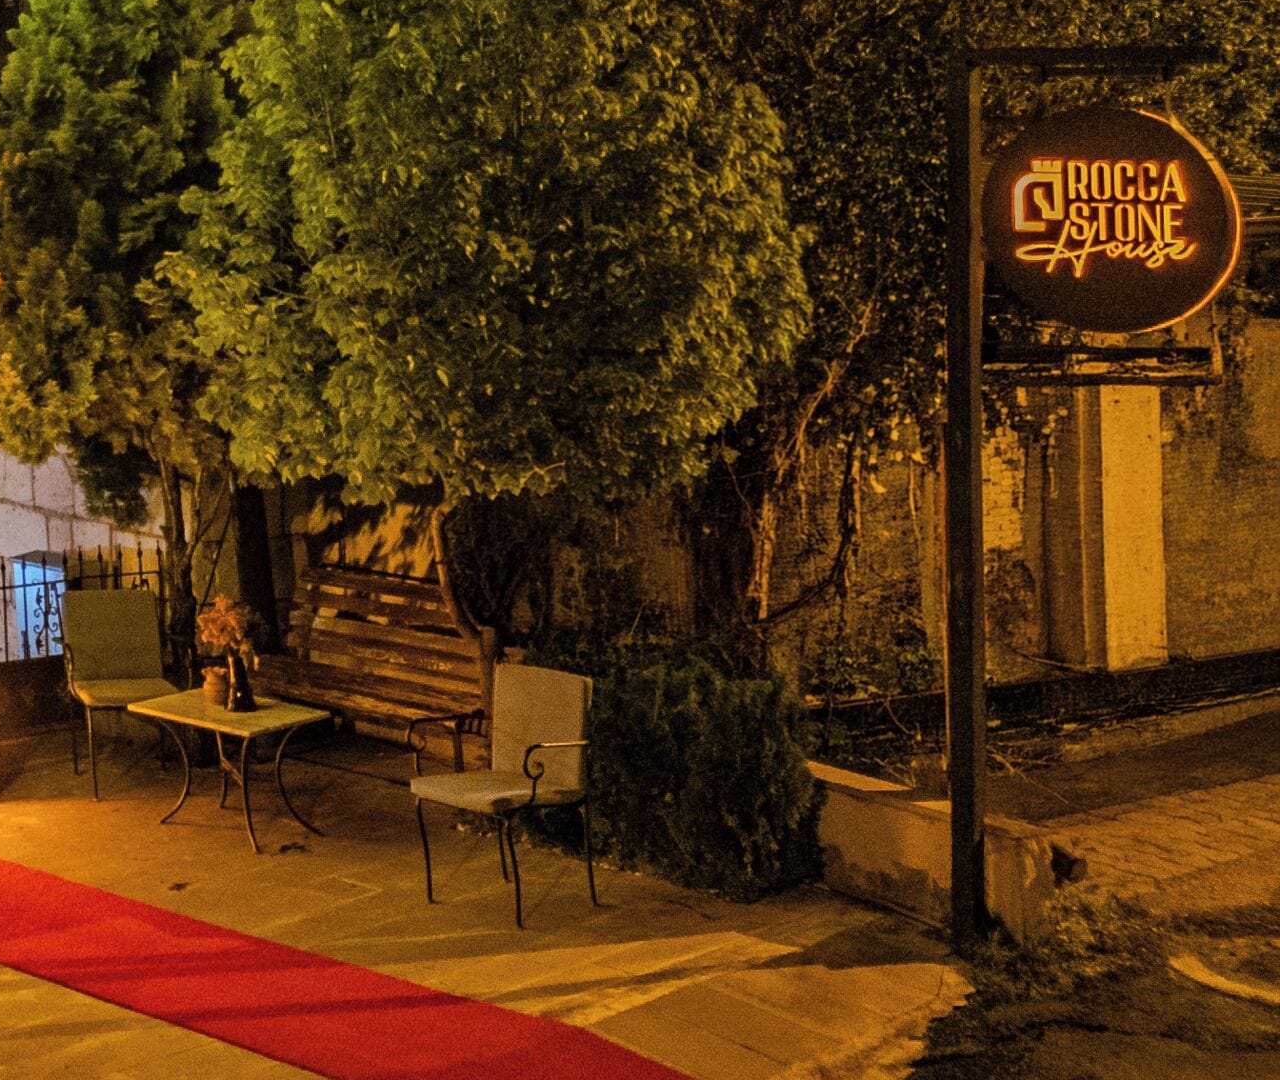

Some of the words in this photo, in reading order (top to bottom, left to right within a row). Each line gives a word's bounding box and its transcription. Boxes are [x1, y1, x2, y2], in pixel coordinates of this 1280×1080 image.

[1067, 159, 1187, 203] ROCCA
[1068, 201, 1183, 245] STONE
[1015, 219, 1197, 279] House
